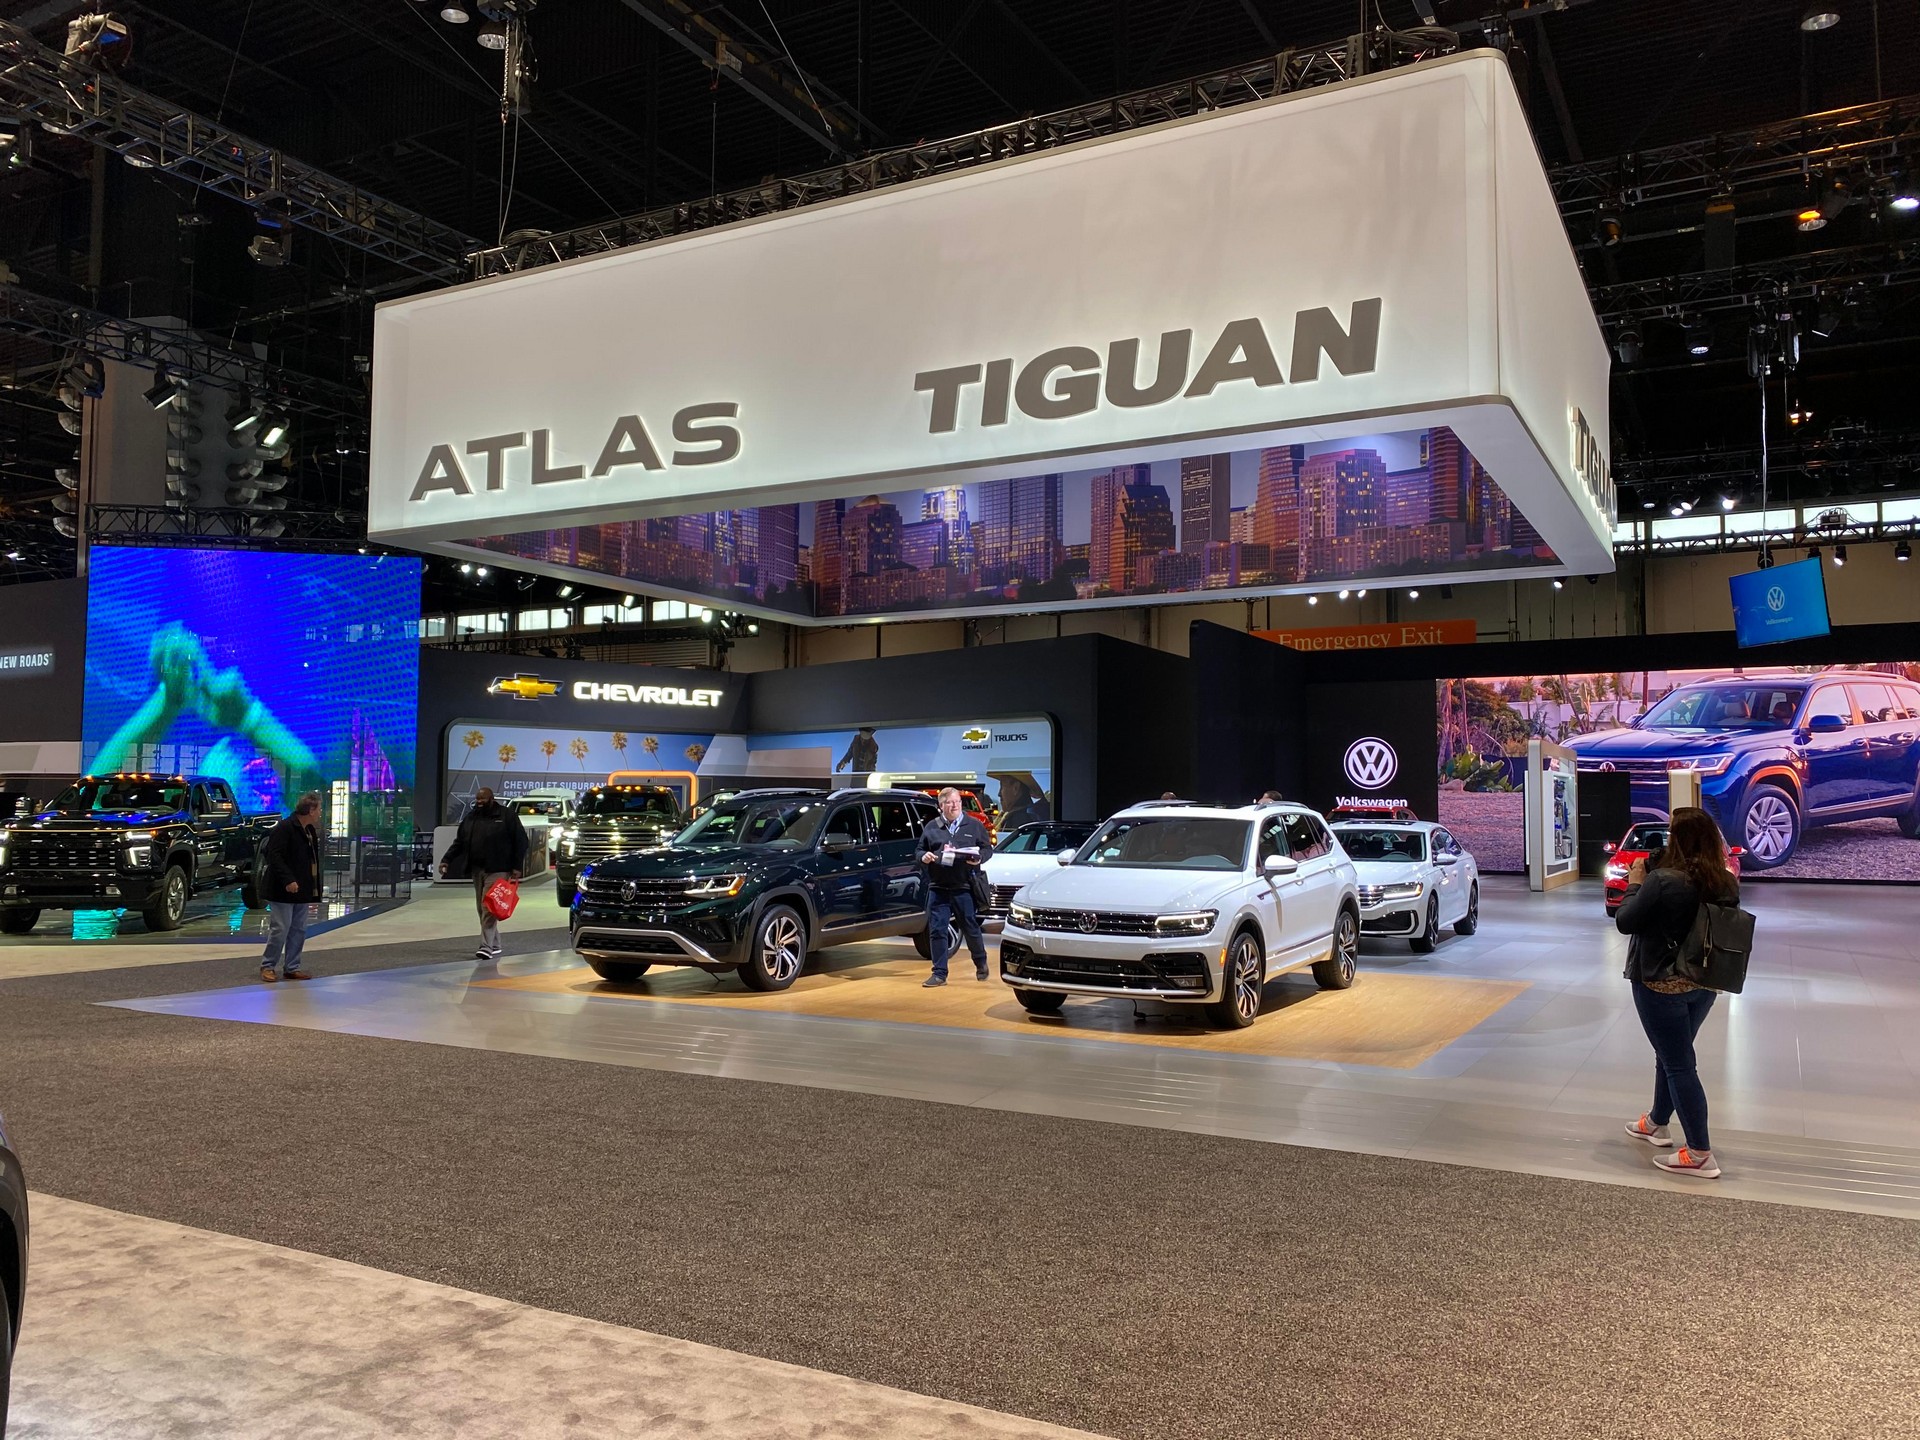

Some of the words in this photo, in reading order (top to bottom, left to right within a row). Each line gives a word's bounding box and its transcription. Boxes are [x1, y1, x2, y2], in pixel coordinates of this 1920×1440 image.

[914, 297, 1382, 434] TIGUAN
[409, 402, 743, 501] ATLAS
[1278, 633, 1391, 650] Emergency
[1401, 626, 1444, 645] Exit
[573, 681, 723, 707] CHEVROLET
[994, 733, 1028, 742] TRUCKS
[503, 780, 558, 790] CHEVROLET
[1335, 796, 1408, 808] Volkswagen
